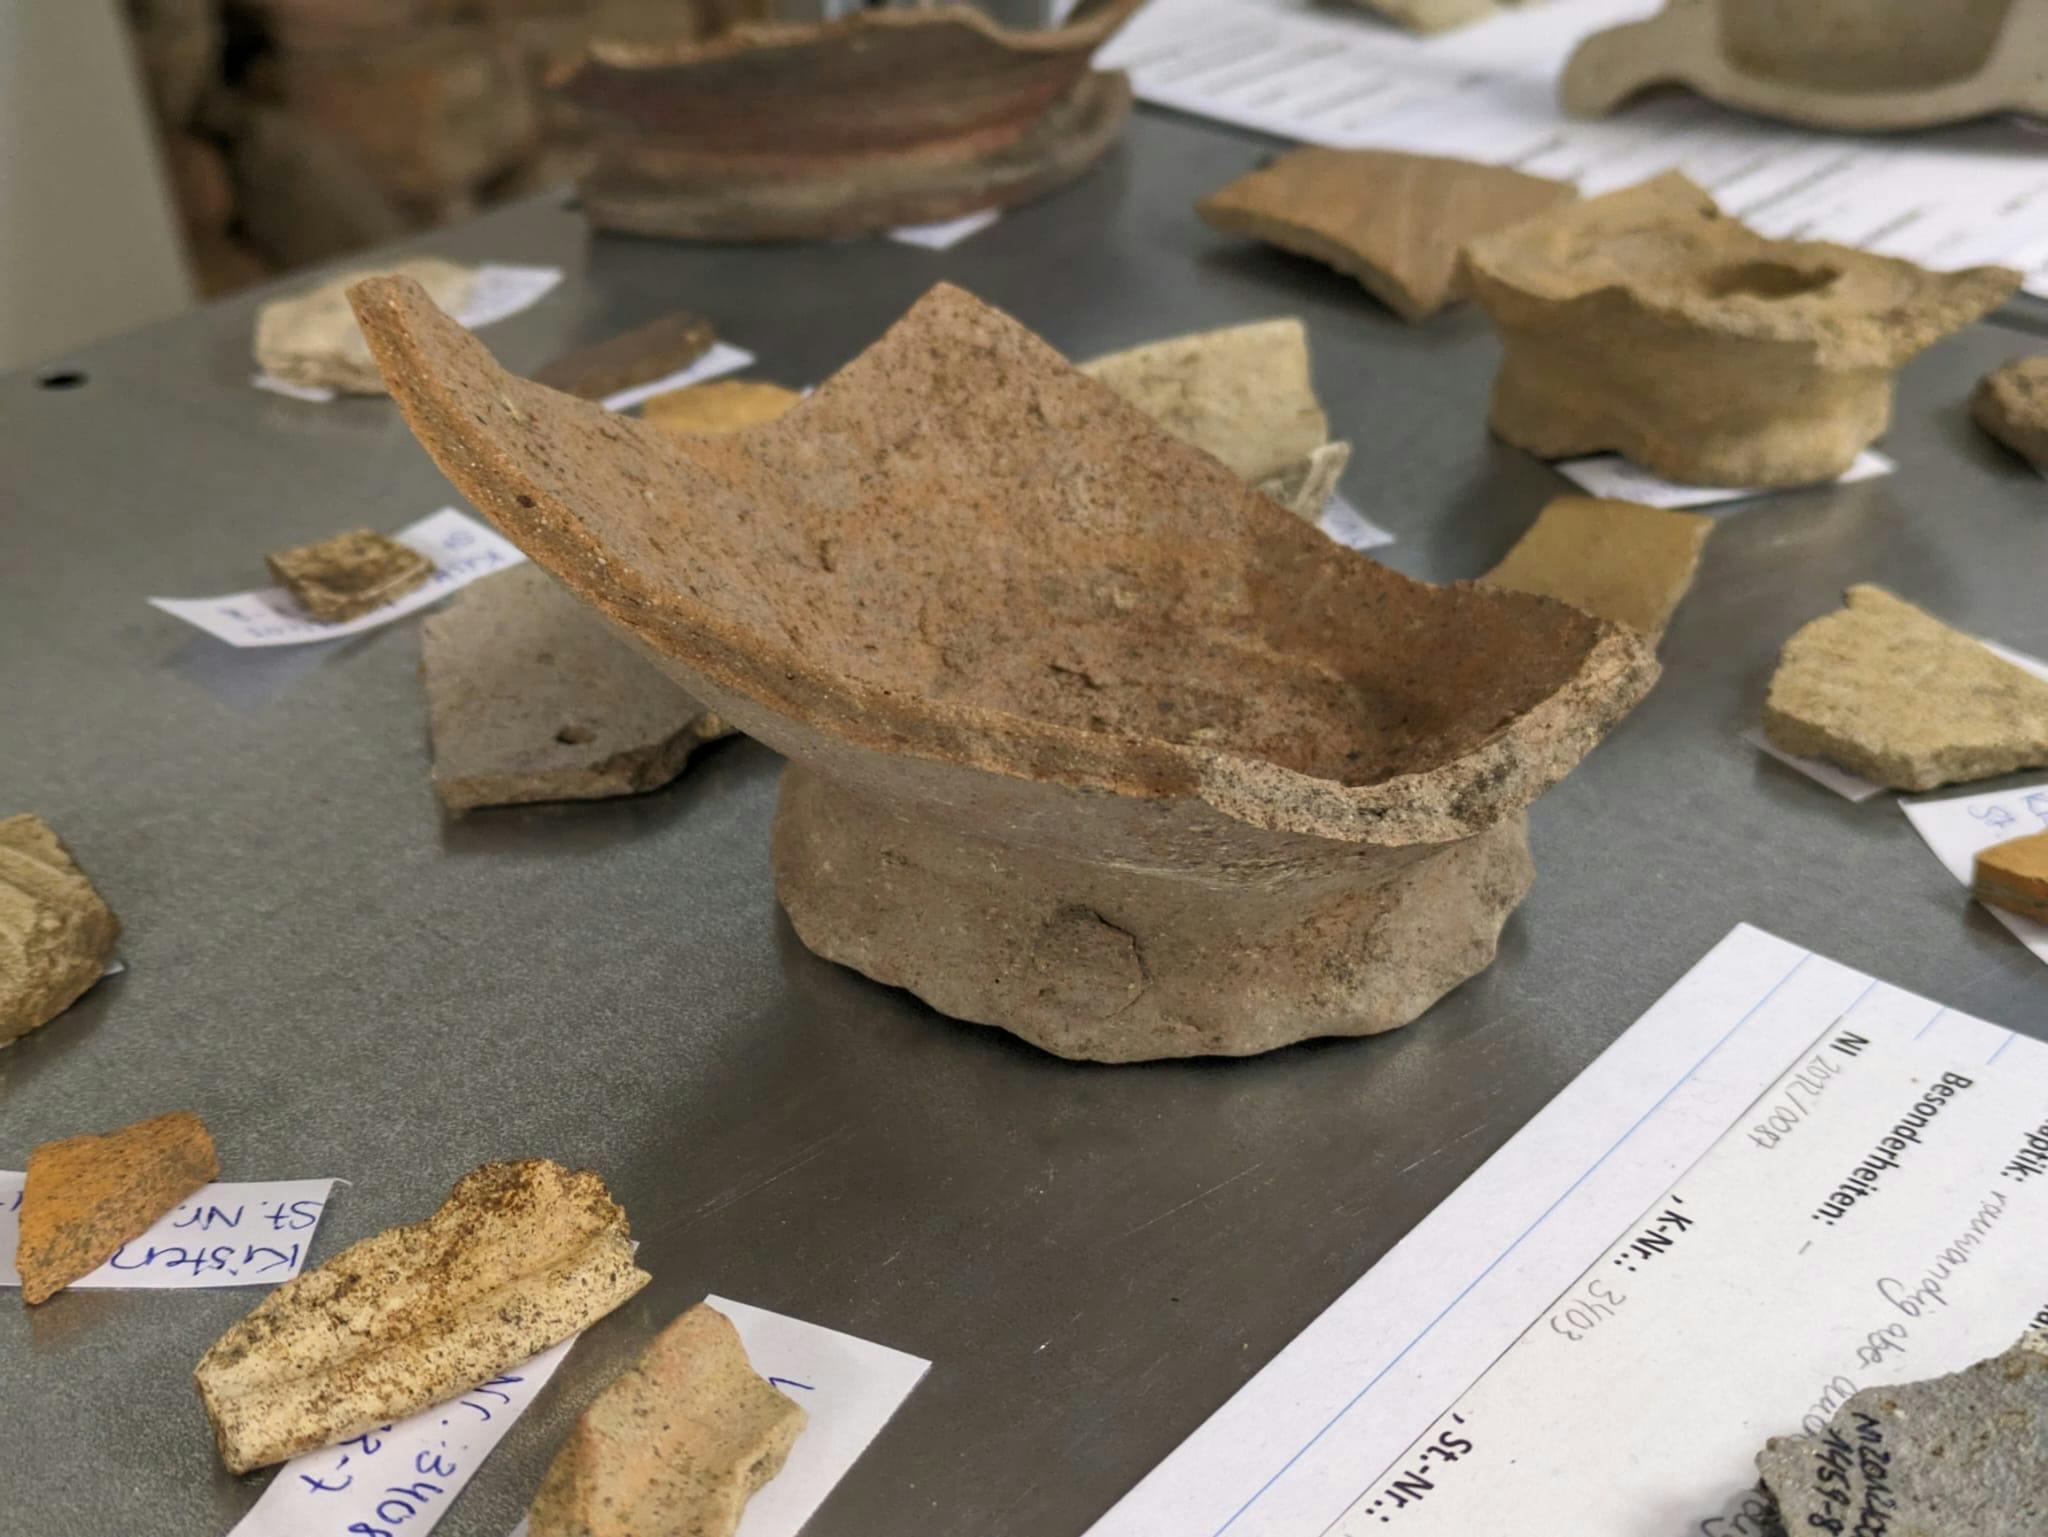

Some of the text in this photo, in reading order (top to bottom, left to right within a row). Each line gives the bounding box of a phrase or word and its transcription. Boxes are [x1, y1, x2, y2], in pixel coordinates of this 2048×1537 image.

[1829, 1029, 1870, 1057] NI
[1810, 1070, 1974, 1226] Besonderheiten:
[1550, 1279, 1627, 1341] 3403
[1856, 1322, 1908, 1370] aber
